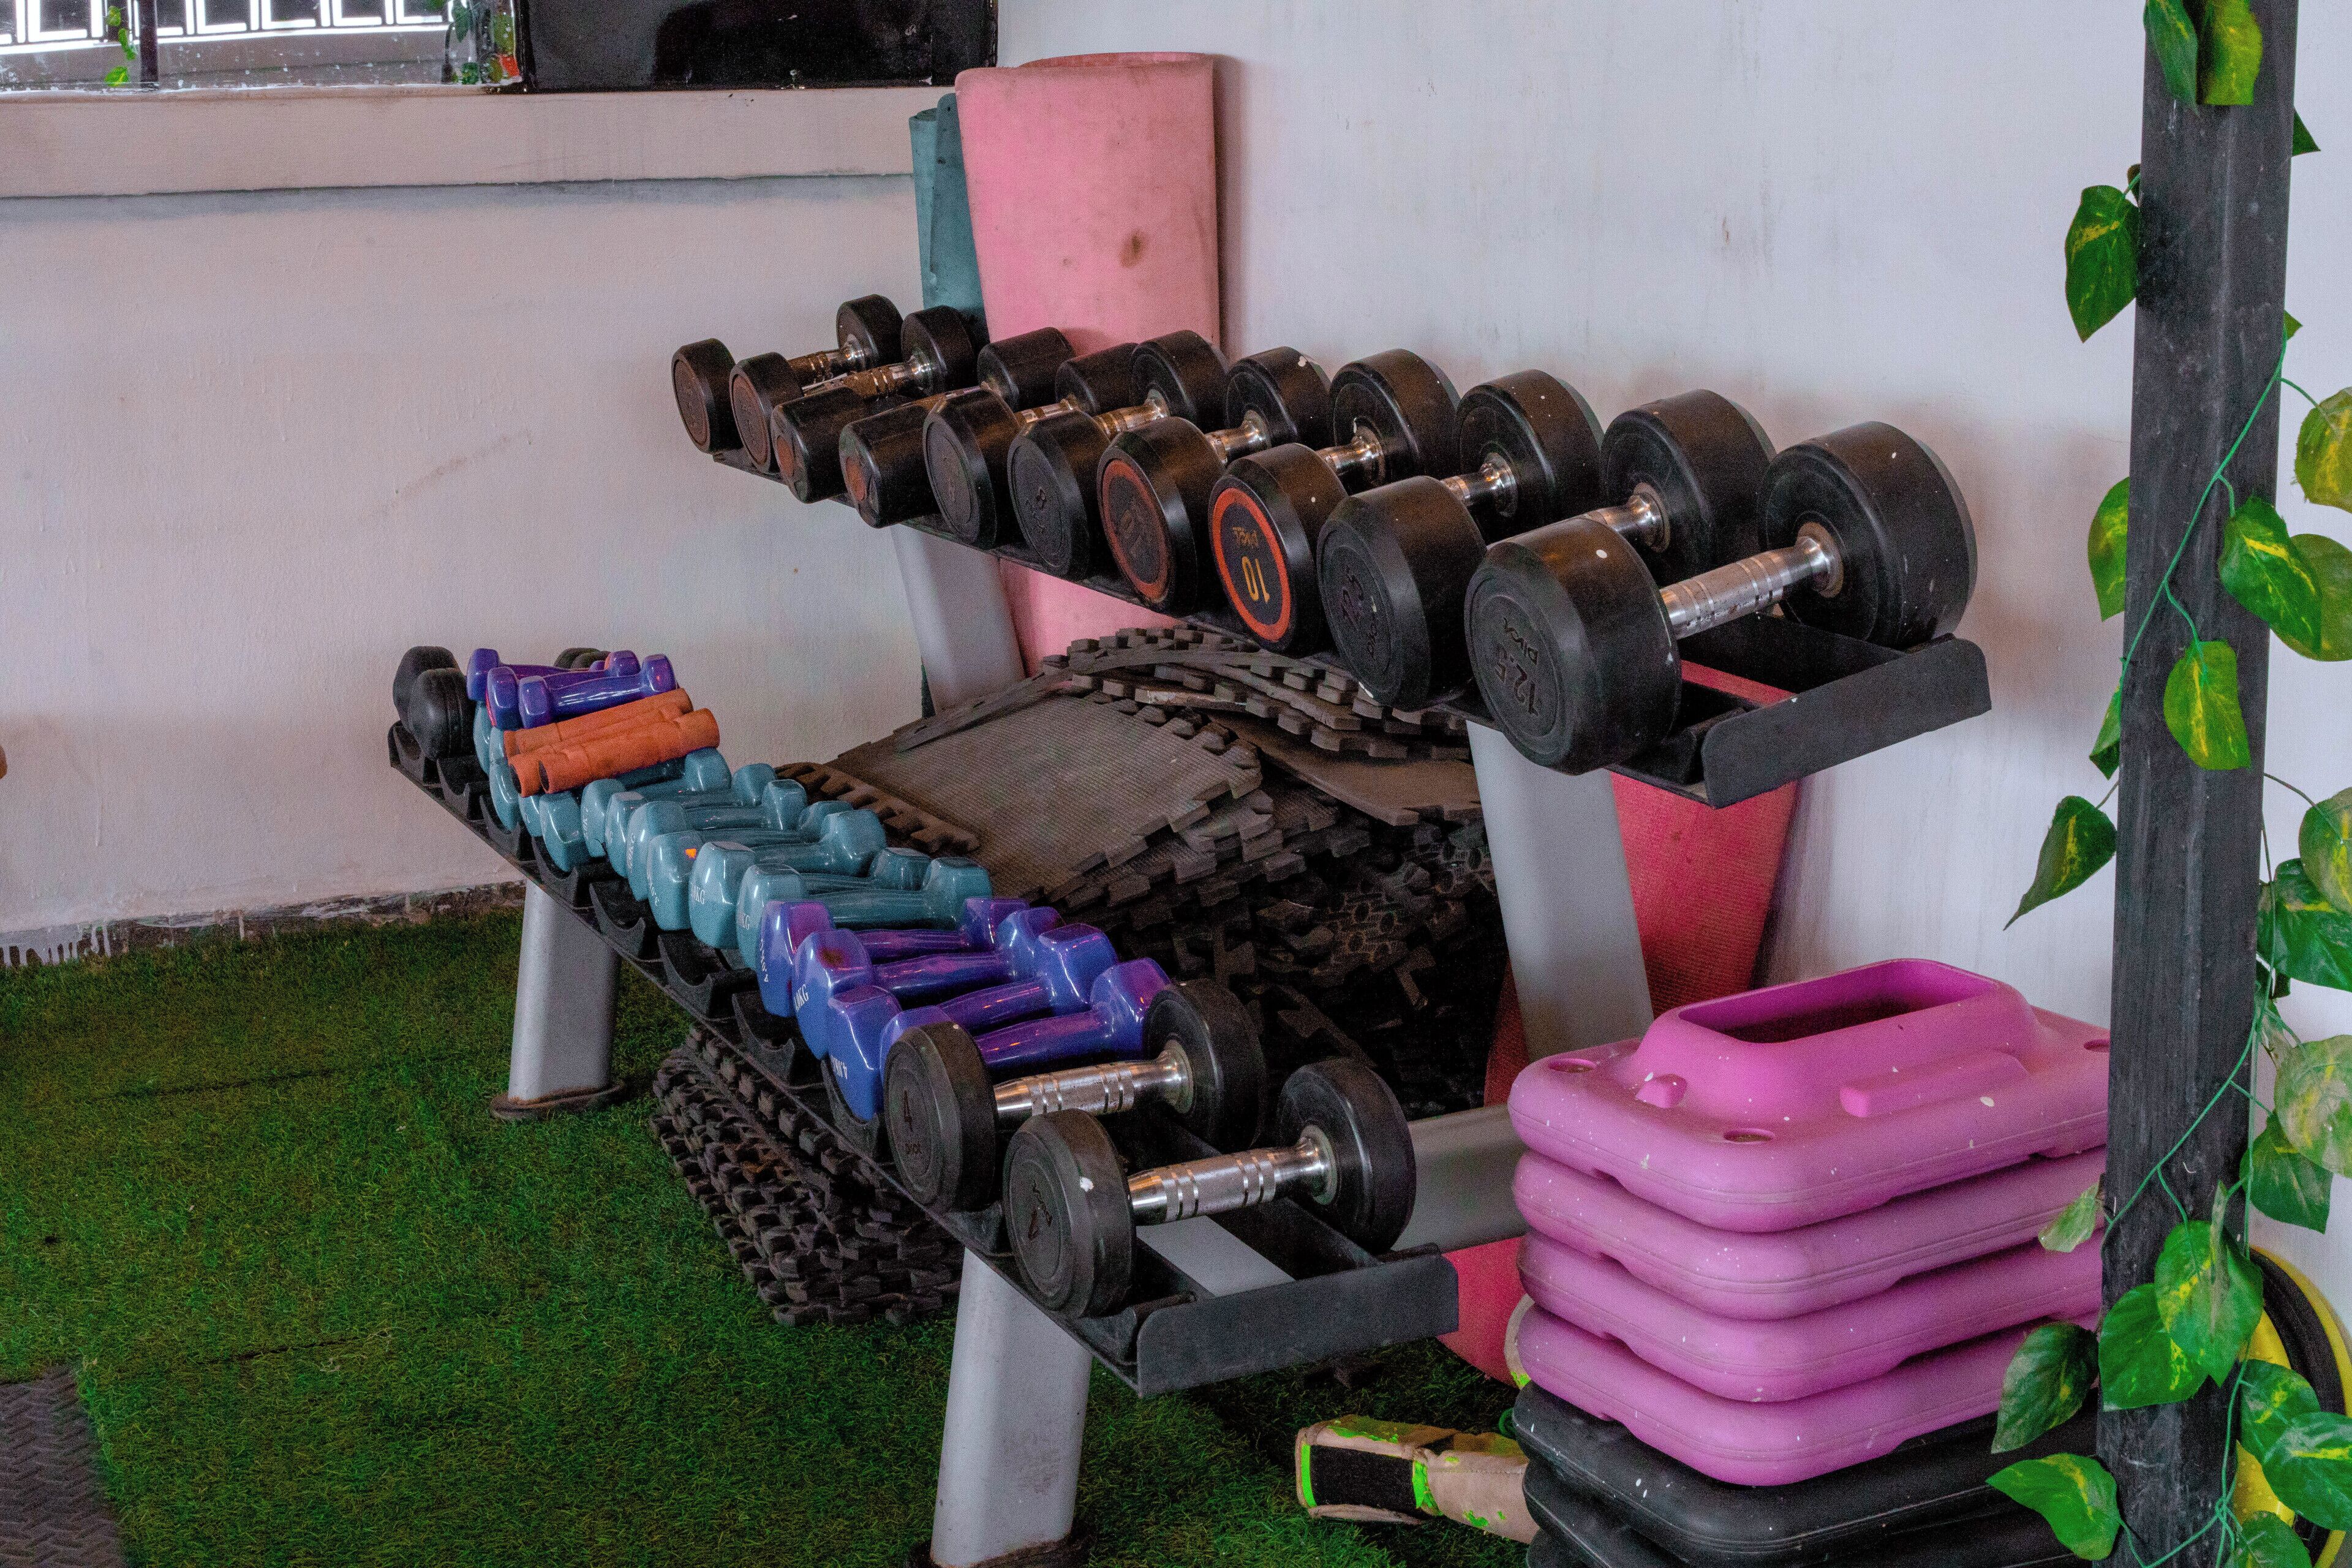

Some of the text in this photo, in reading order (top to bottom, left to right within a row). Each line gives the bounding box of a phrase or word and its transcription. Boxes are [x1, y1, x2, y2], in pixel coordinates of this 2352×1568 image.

[1241, 556, 1270, 603] 10
[1494, 643, 1539, 717] 12.5
[902, 1089, 914, 1133] 4
